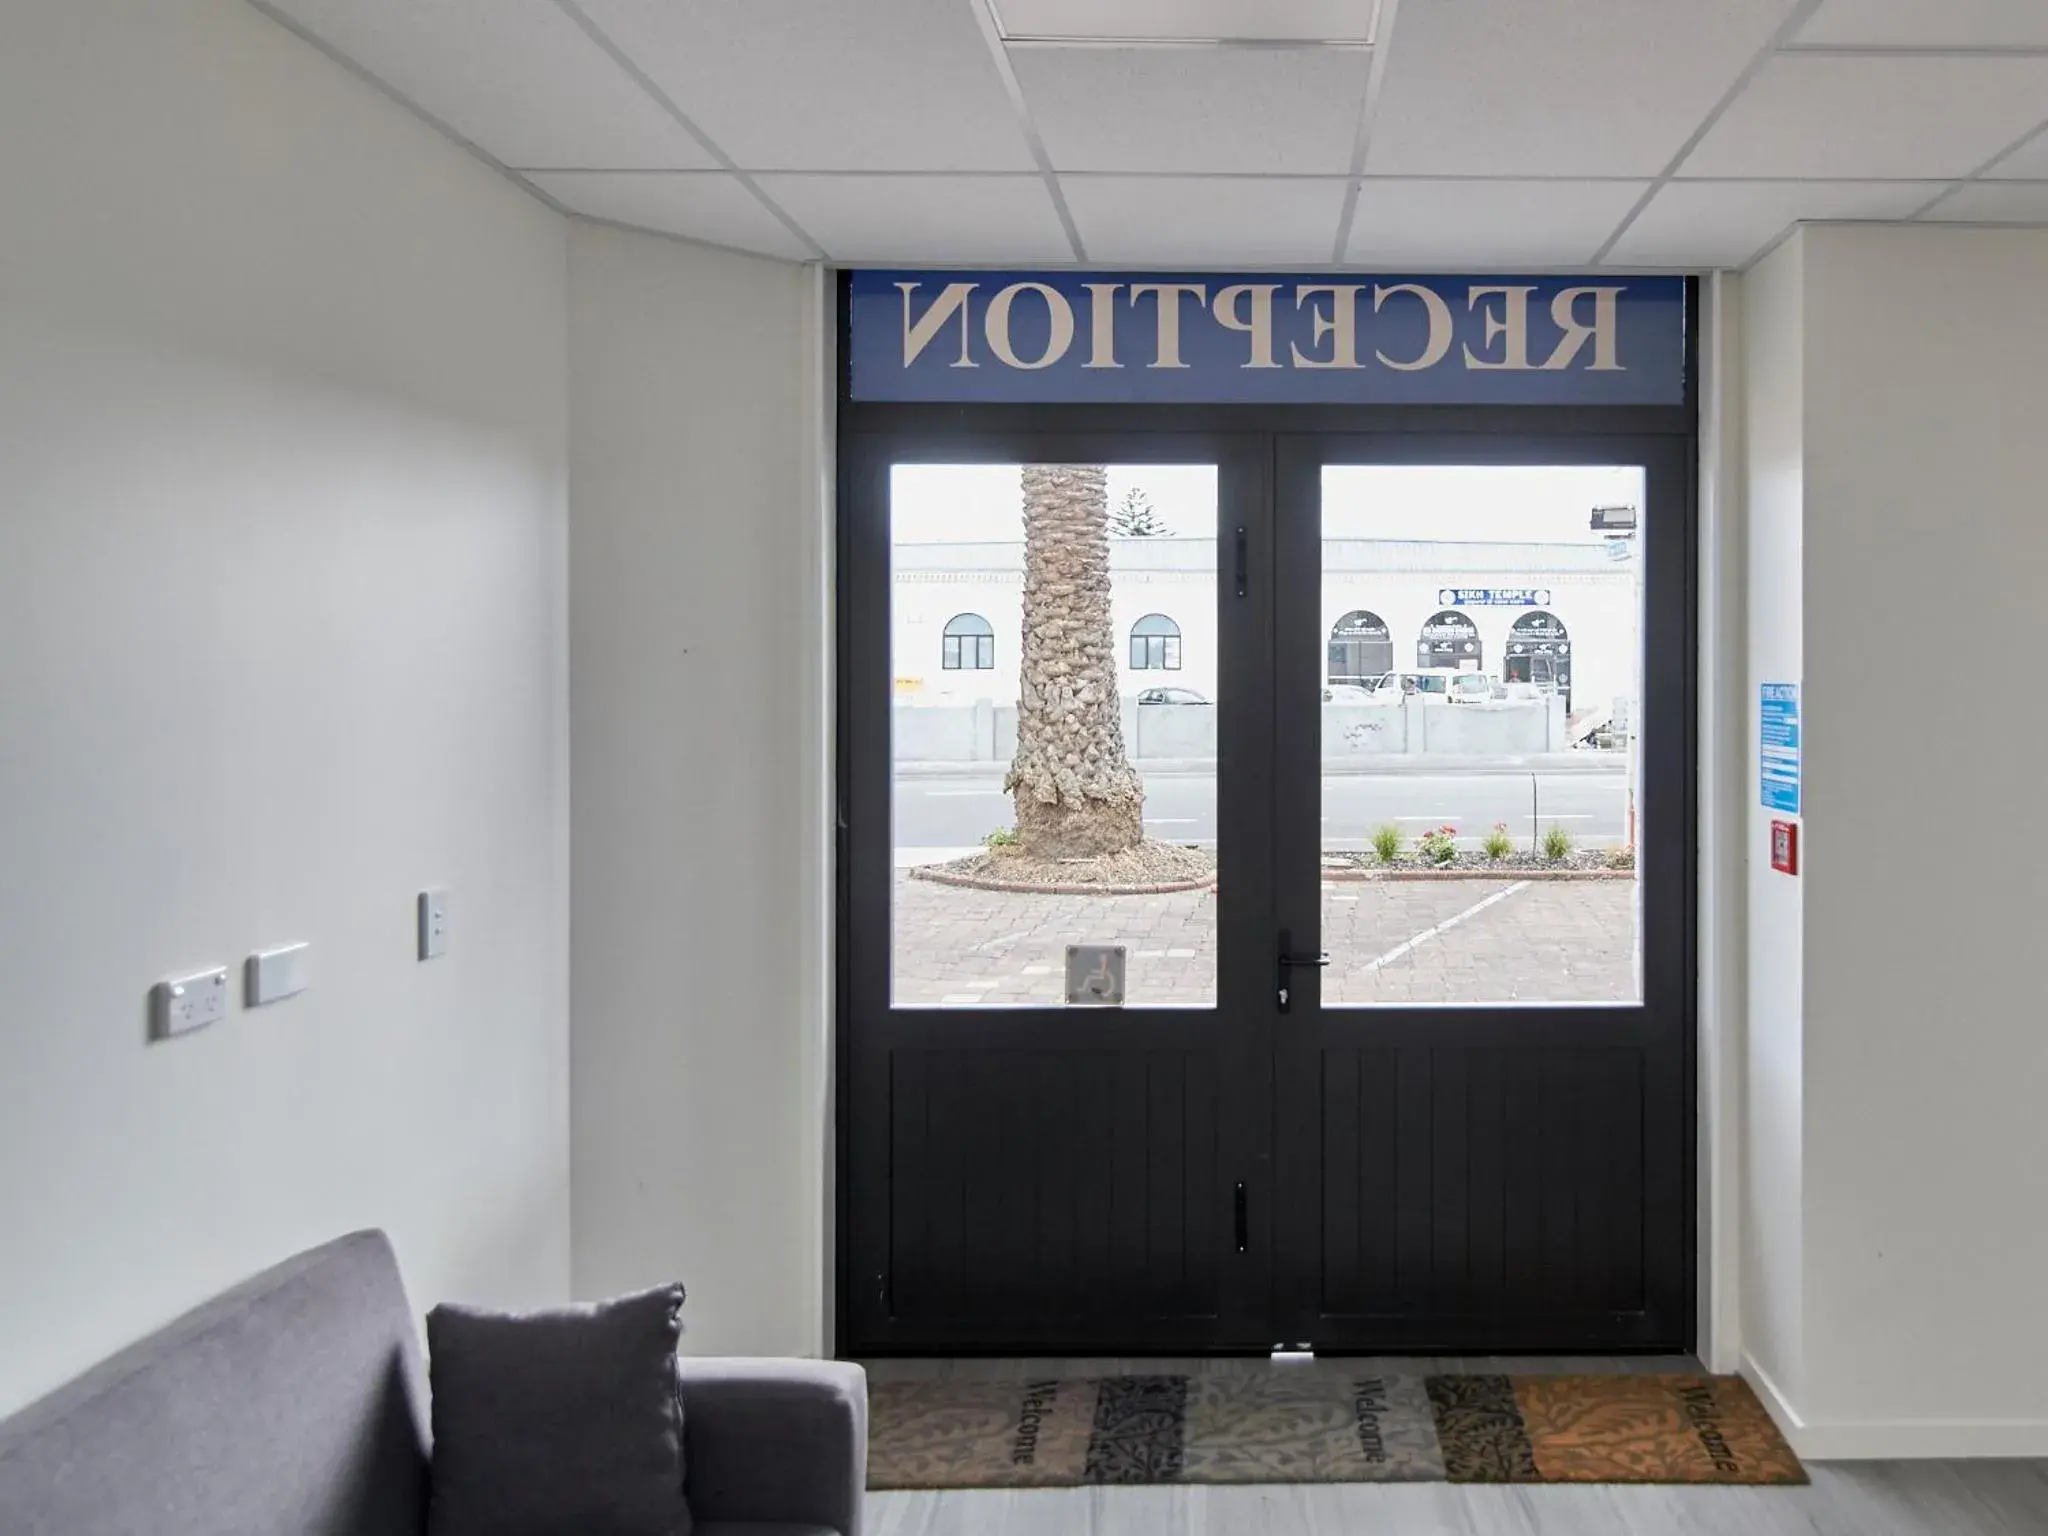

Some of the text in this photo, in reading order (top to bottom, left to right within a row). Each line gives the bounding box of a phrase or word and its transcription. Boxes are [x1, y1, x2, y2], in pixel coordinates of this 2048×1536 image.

[1457, 590, 1533, 600] SIKH TEMPLE
[1013, 1381, 1060, 1465] Welcome
[1353, 1379, 1391, 1464] Welcome
[1679, 1386, 1741, 1474] Welcome
